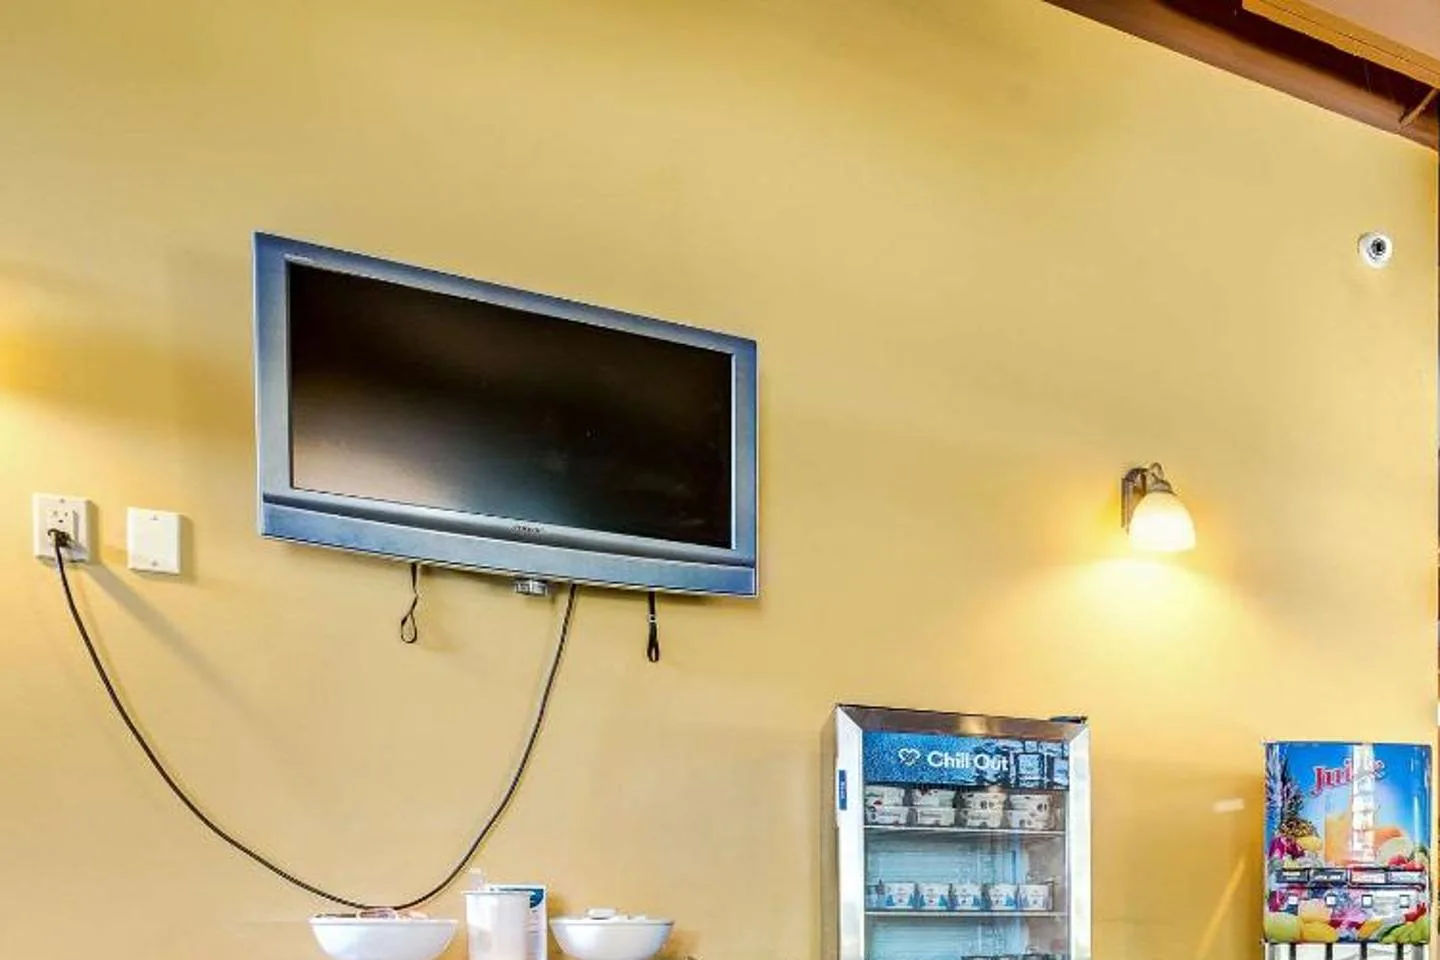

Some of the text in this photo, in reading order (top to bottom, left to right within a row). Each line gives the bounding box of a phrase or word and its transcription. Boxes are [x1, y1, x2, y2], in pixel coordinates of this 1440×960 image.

[927, 751, 1009, 772] Chill Out
[1311, 757, 1386, 798] Juie
